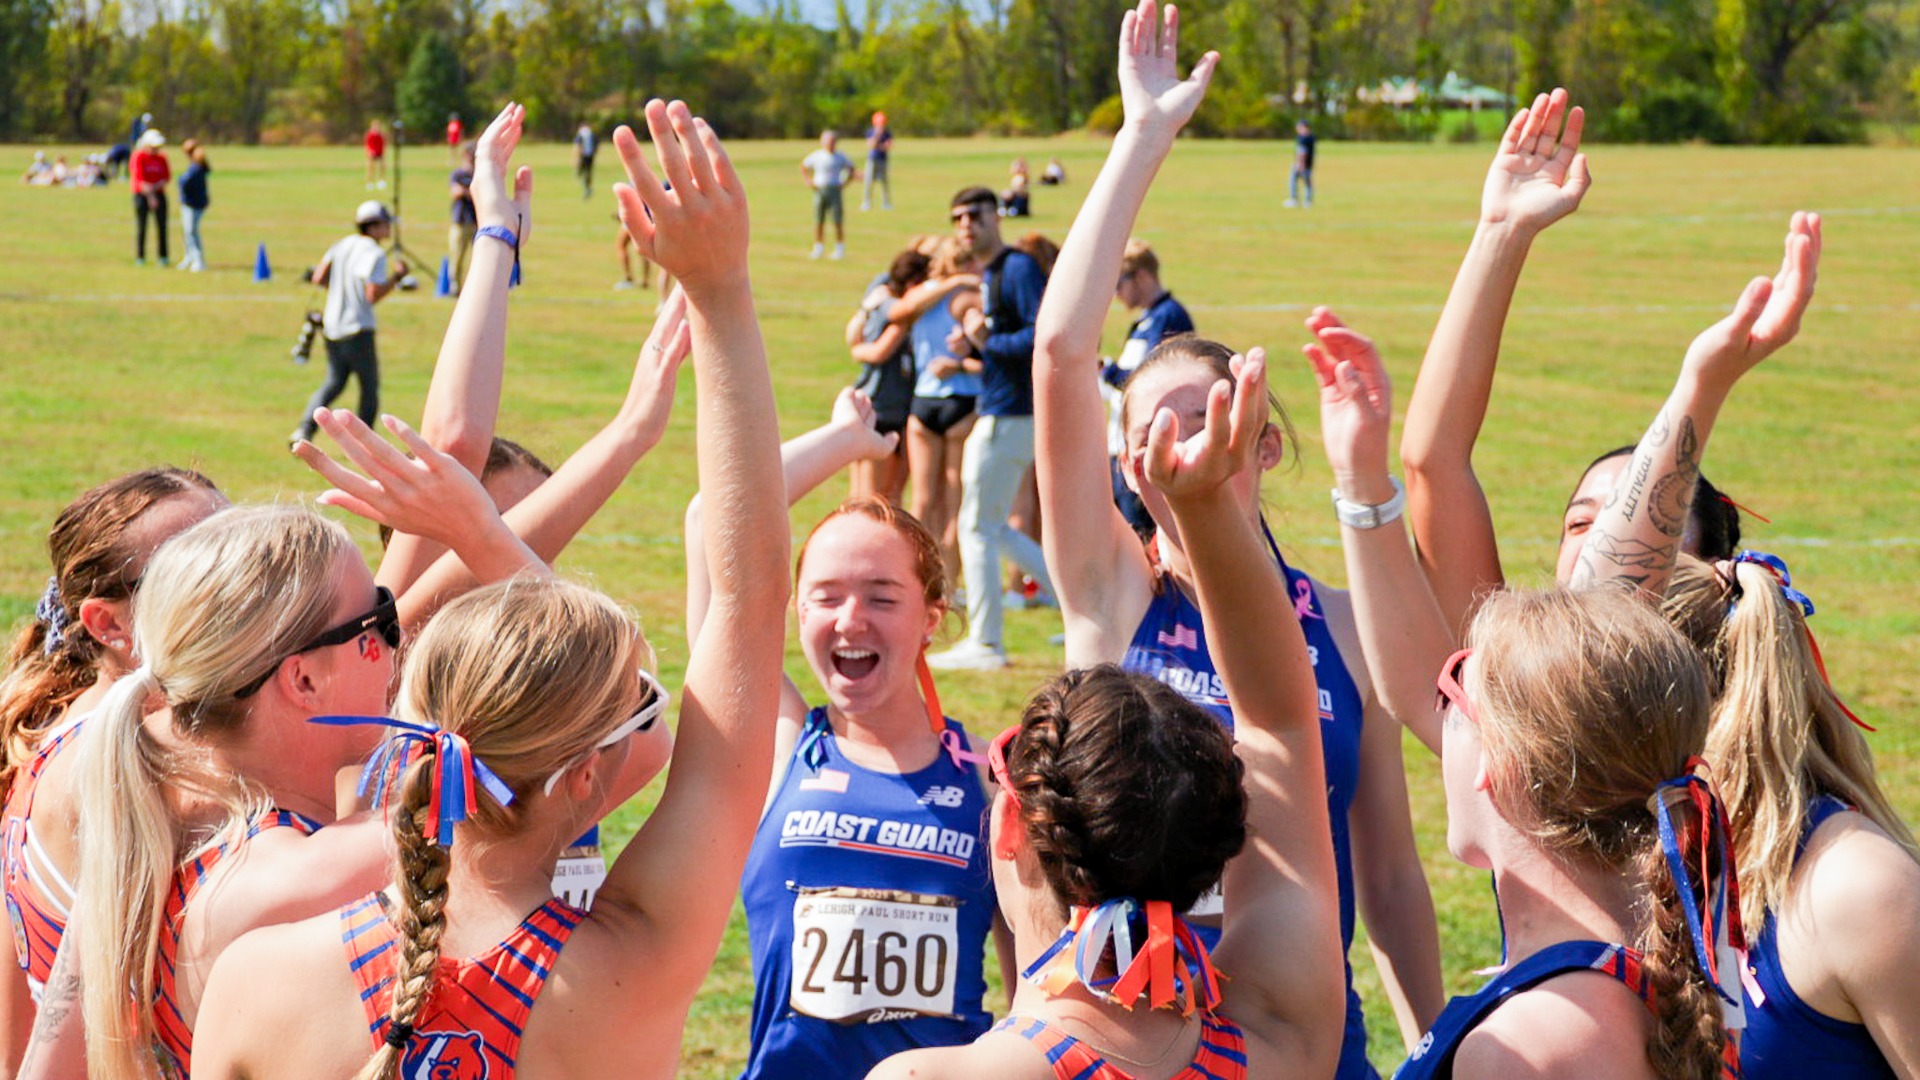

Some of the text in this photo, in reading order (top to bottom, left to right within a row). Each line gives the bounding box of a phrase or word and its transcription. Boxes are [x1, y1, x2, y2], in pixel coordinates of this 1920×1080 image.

[1623, 455, 1653, 522] TOTALITY
[1159, 667, 1227, 696] COAS
[782, 810, 975, 859] COAST GUARD
[818, 904, 856, 915] LEHIGH
[860, 905, 889, 917] PAUL
[892, 909, 925, 921] SHORT
[928, 912, 950, 923] RUN
[801, 927, 948, 997] 2460
